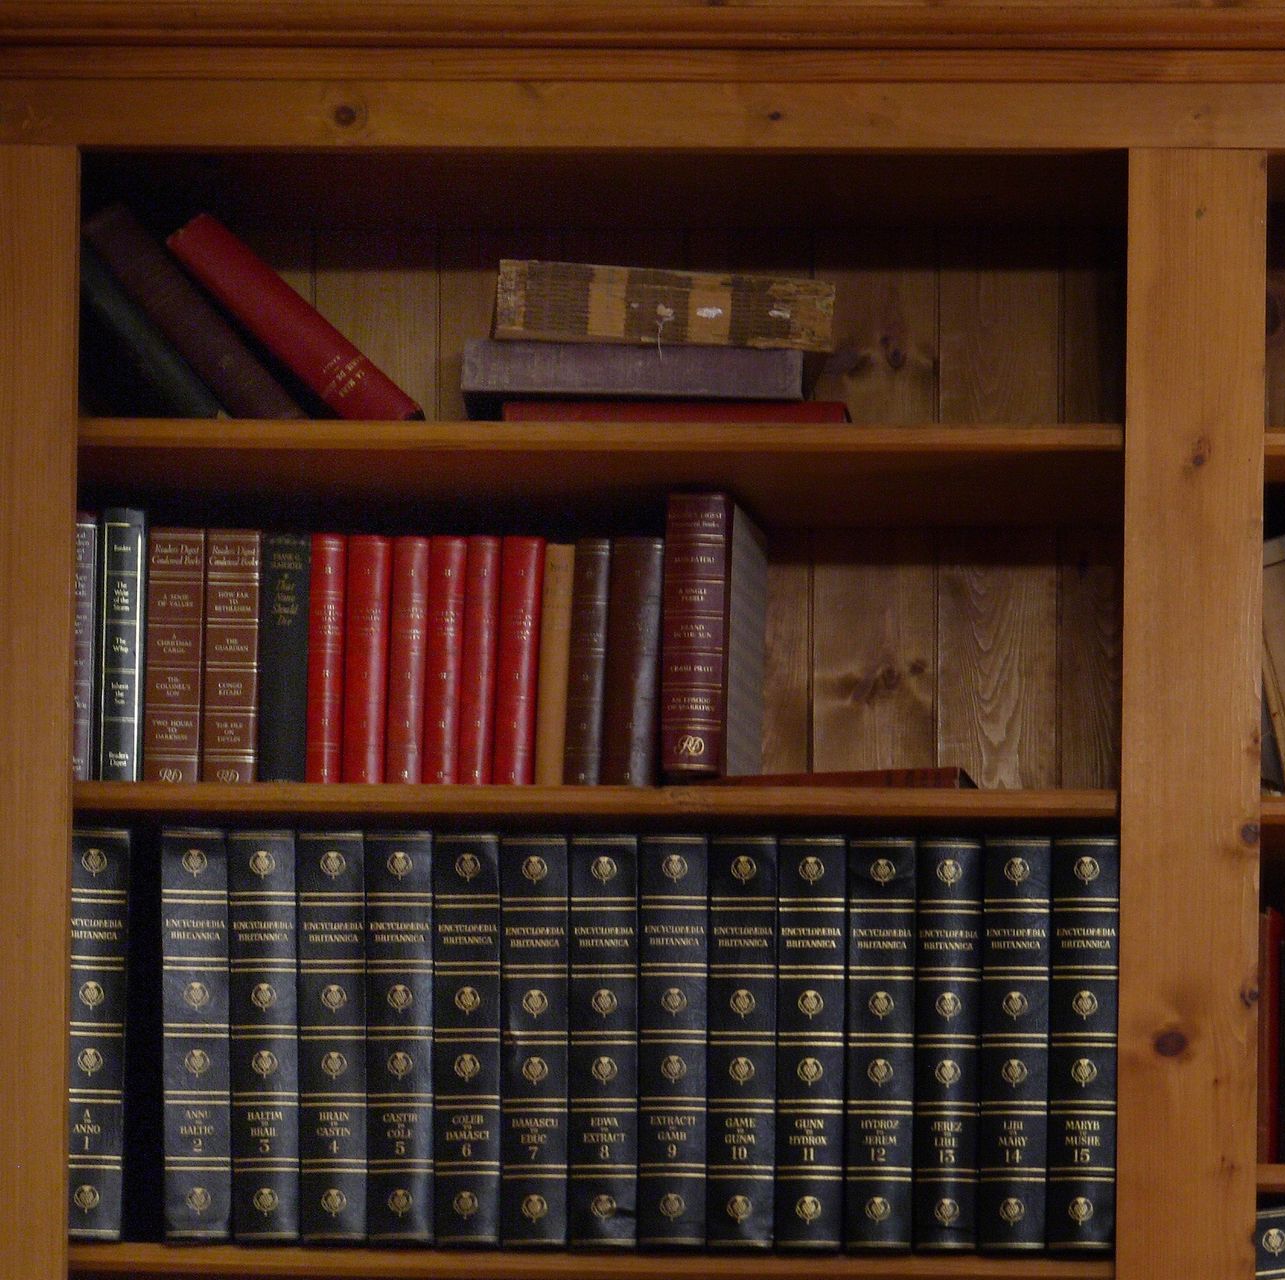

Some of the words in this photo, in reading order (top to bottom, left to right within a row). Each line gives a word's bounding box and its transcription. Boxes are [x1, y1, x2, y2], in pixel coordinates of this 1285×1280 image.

[170, 932, 221, 940] BRITANNICA
[238, 932, 289, 942] BRITANNICA
[308, 934, 359, 943] BRITANNICA
[374, 934, 425, 943] BRITANNICA
[443, 936, 493, 946] BRITANNICA
[510, 939, 560, 948] BRITANNICA
[579, 938, 629, 948] BRITANNICA
[650, 937, 700, 946] BRITANNICA
[718, 938, 768, 948] BRITANNICA
[786, 940, 836, 948] BRITANNICA
[857, 940, 907, 950] BRITANNICA
[924, 942, 974, 951] BRITANNICA
[991, 940, 1041, 950] BRITANNICA
[1061, 940, 1111, 950] BRITANNICA
[318, 1112, 350, 1121] BRAIN
[724, 1118, 756, 1128] GAME
[794, 1119, 824, 1129] GUNN
[72, 1124, 101, 1134] ANNO
[83, 1136, 90, 1150] 1
[724, 1134, 756, 1144] GUNM
[789, 1136, 828, 1146] HYDROX
[864, 1136, 897, 1145] JEREM
[192, 1138, 202, 1152] 2
[260, 1139, 270, 1152] 3
[328, 1140, 339, 1154] 4
[395, 1142, 405, 1155] 5
[462, 1144, 472, 1158] 6
[528, 1146, 538, 1160] 7
[599, 1146, 610, 1159] 8
[667, 1145, 677, 1158] 9
[731, 1146, 748, 1160] 10
[803, 1148, 814, 1162] 11
[870, 1148, 886, 1162] 12
[1073, 1148, 1090, 1163] 15
[938, 1150, 956, 1164] 13
[1004, 1149, 1022, 1164] 14
